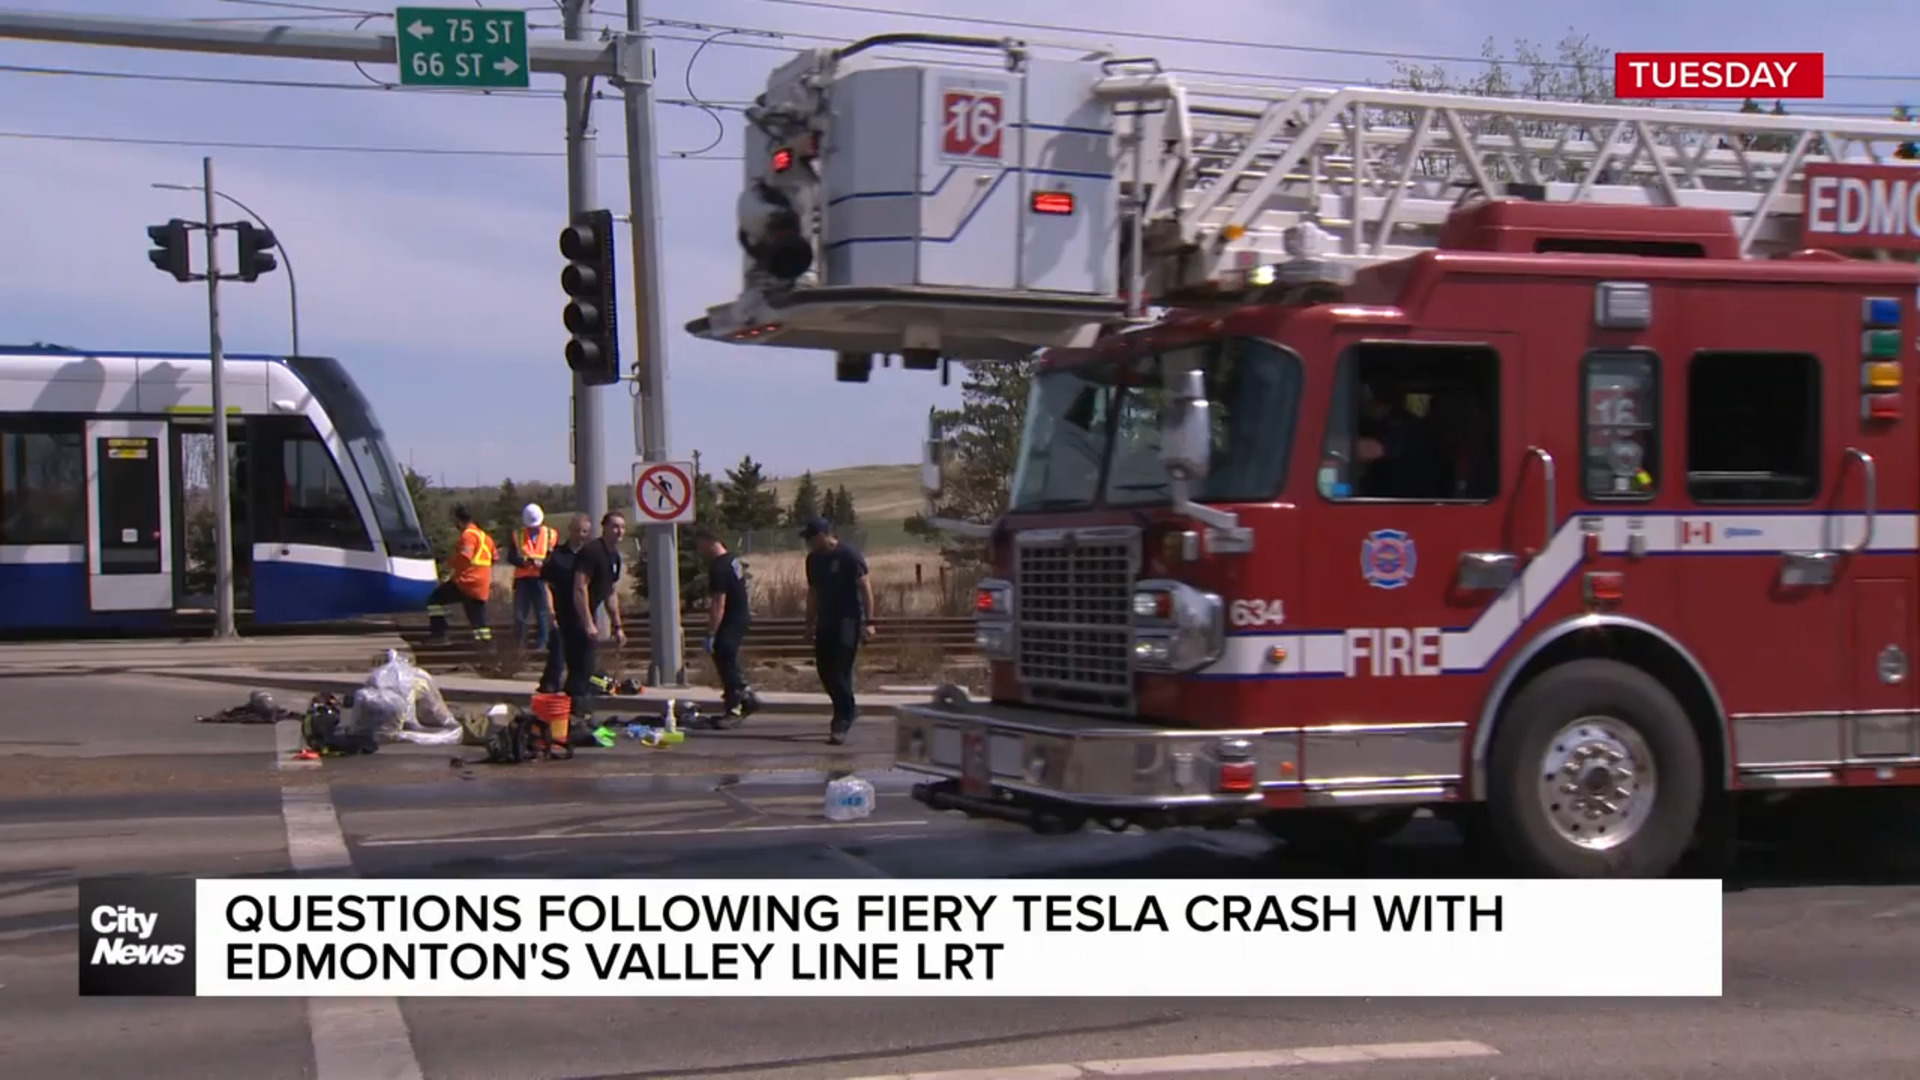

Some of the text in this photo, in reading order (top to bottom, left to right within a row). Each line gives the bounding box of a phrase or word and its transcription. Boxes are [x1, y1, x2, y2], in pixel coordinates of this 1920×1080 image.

[446, 18, 513, 44] 75 ST
[412, 52, 483, 77] 66 ST
[948, 100, 998, 146] 16
[1595, 398, 1635, 437] 16
[1230, 598, 1285, 626] 634
[1345, 627, 1442, 678] FIRE
